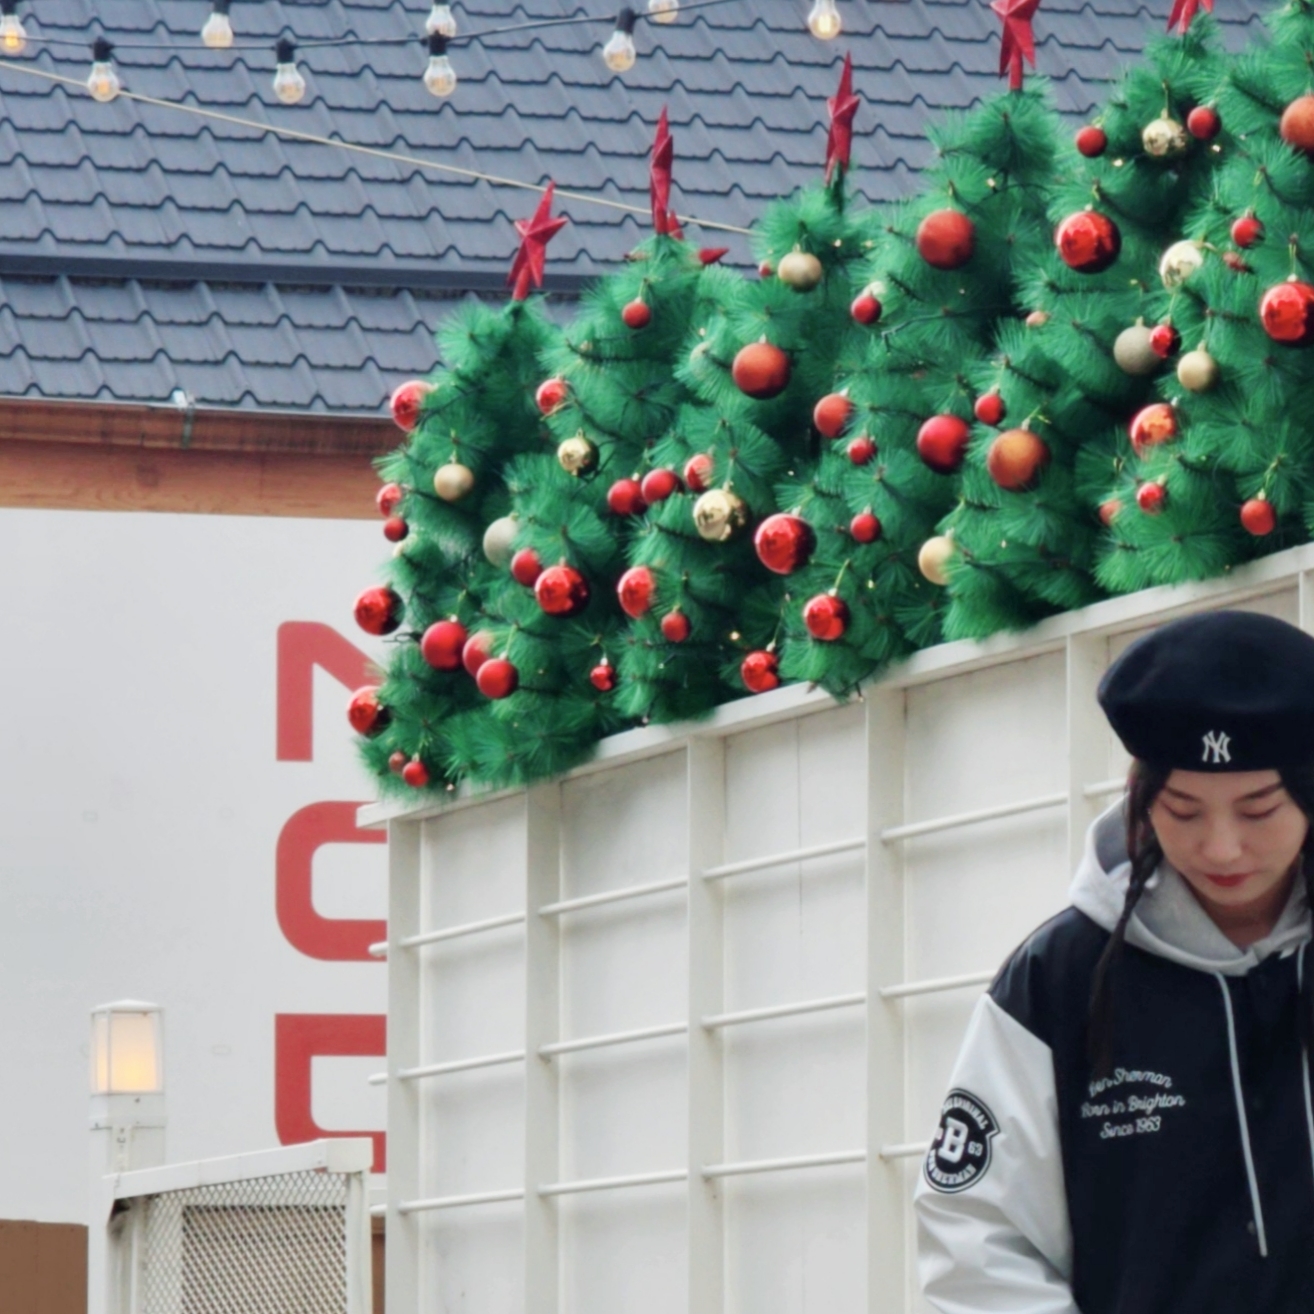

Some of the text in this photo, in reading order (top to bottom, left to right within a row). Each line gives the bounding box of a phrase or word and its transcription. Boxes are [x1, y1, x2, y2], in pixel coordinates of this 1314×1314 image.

[1202, 730, 1231, 763] NY
[1113, 1067, 1172, 1088] Sherman
[1112, 1099, 1126, 1113] in
[1127, 1093, 1186, 1115] Brighton
[1099, 1115, 1162, 1139] Since 1963
[938, 1116, 969, 1163] B
[967, 1141, 984, 1157] 63
